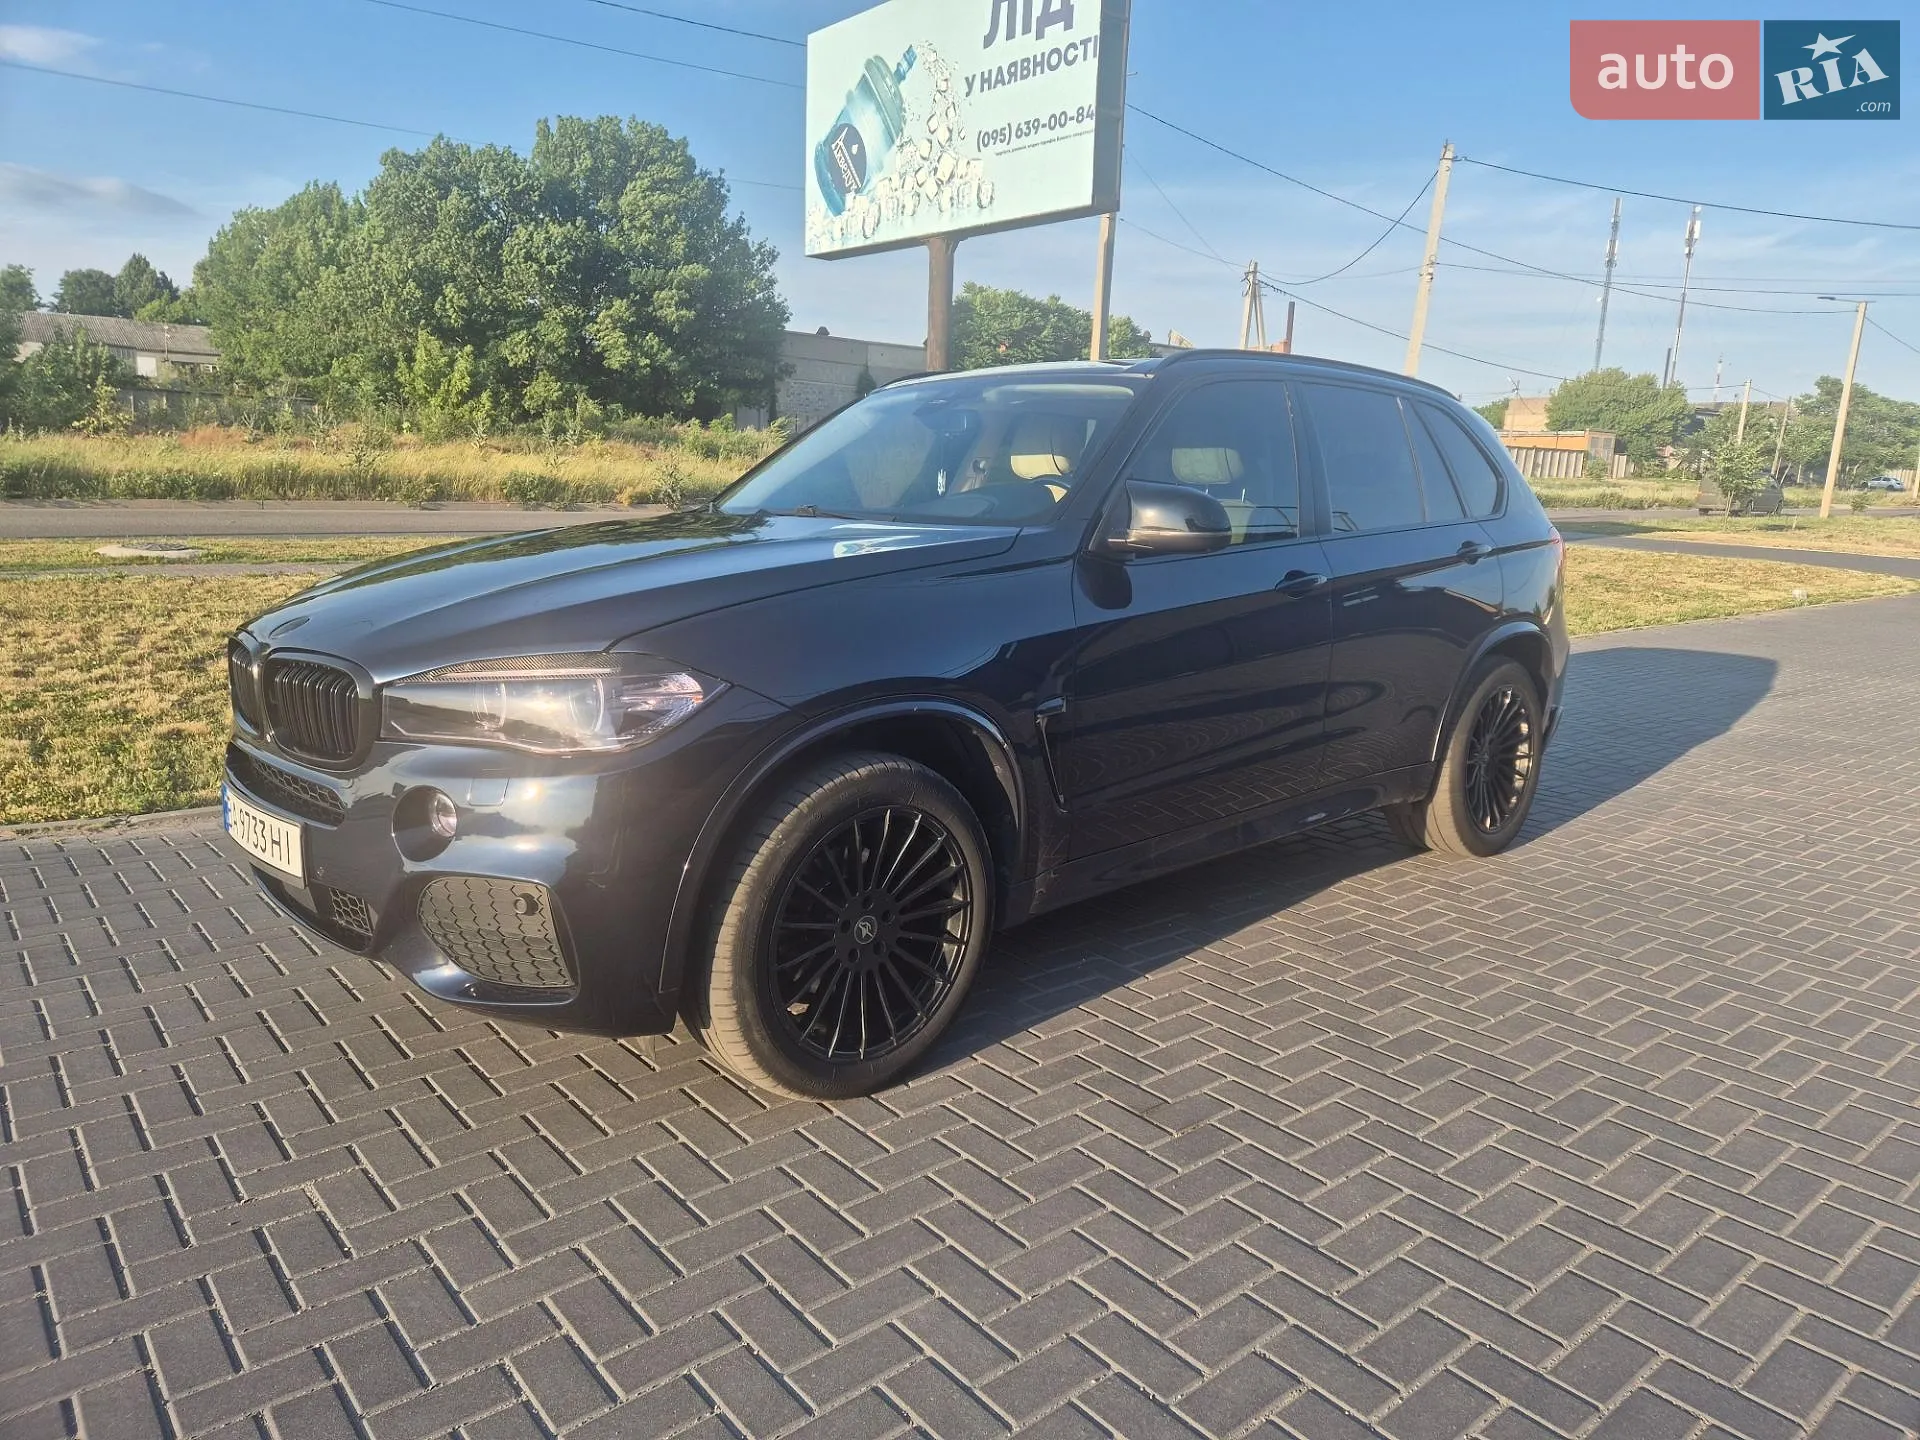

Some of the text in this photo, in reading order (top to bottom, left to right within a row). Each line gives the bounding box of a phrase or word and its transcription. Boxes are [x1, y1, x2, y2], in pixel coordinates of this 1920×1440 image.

[980, 35, 1099, 93] НАЯВНОСТІ
[976, 122, 1012, 152] (095)
[1015, 104, 1095, 140] 639-00-84
[240, 808, 267, 853] 9733
